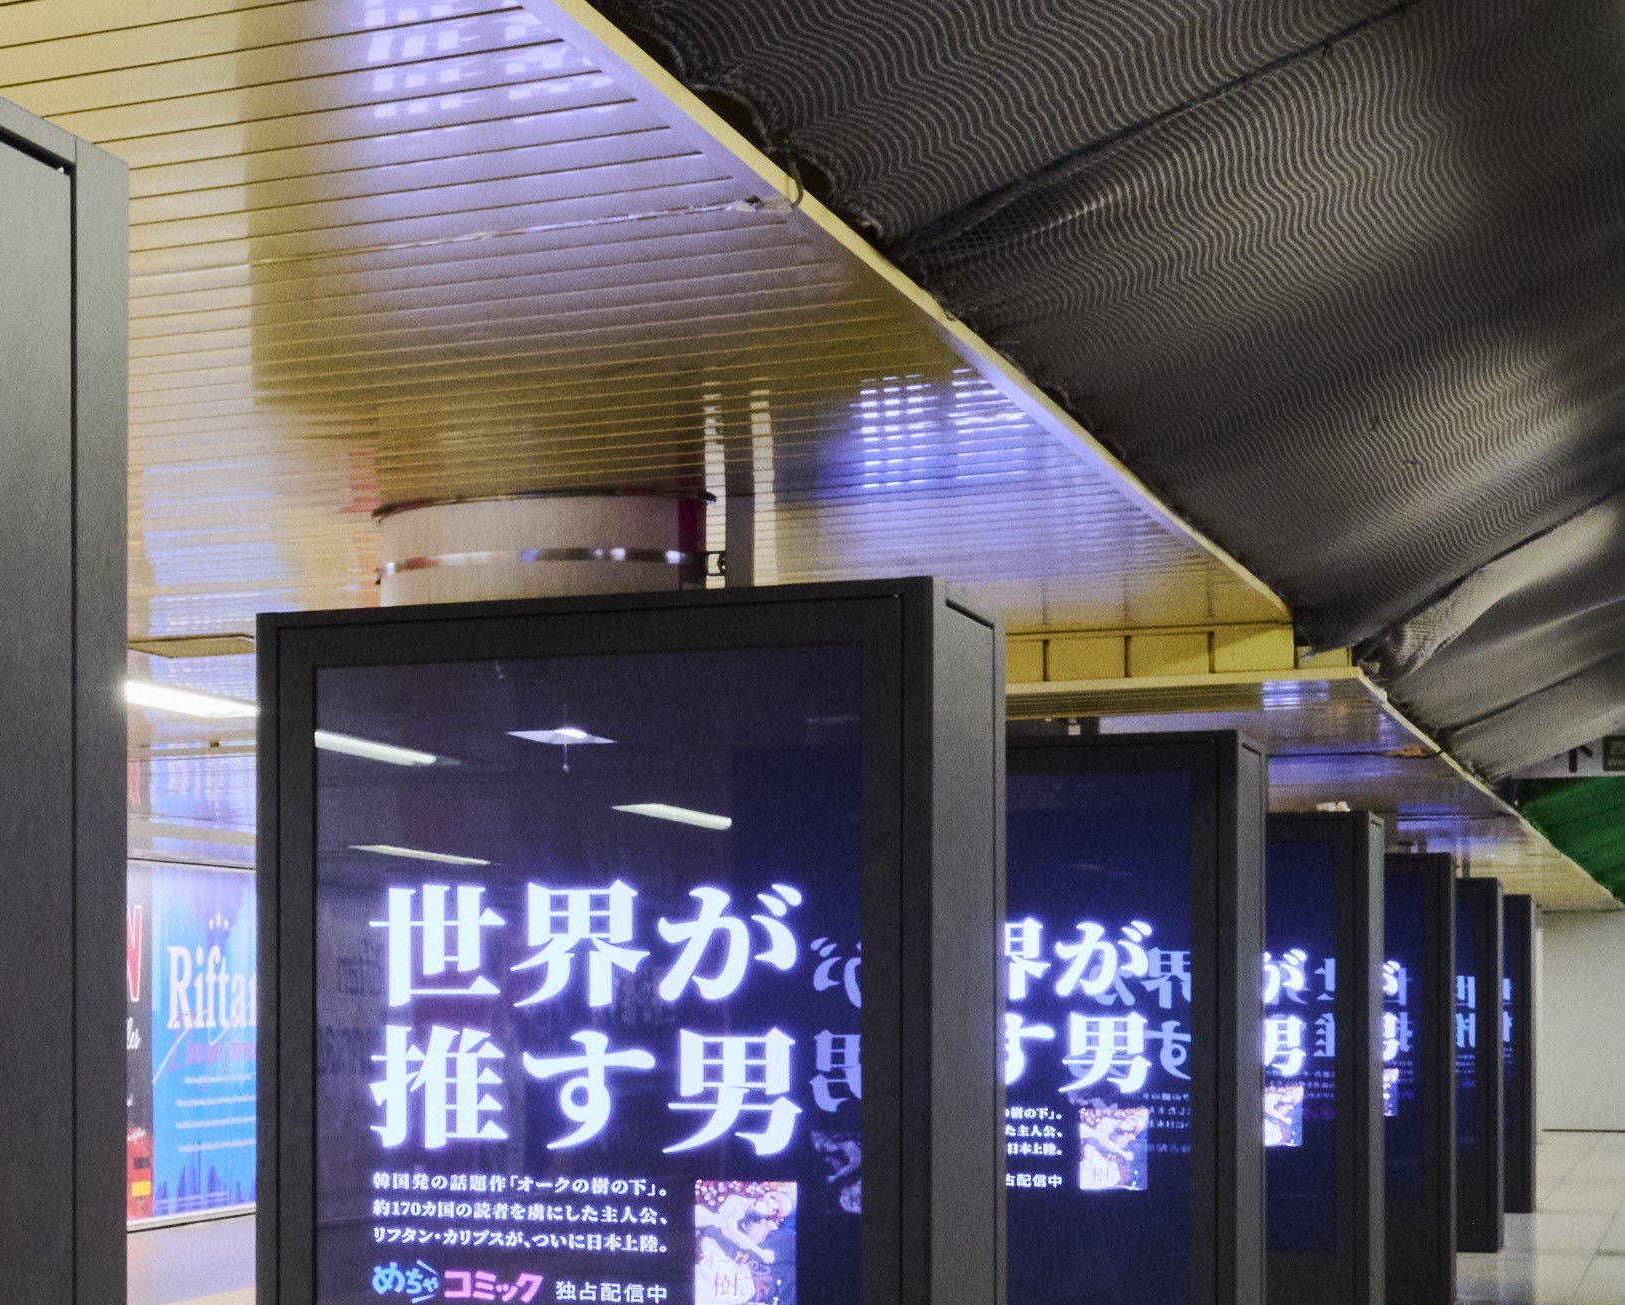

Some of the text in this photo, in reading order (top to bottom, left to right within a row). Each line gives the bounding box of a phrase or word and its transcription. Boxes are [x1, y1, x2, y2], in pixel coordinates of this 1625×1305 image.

[369, 880, 802, 1007] 世界が
[369, 1024, 802, 1155] 推す男
[555, 1279, 668, 1304] 独占配信中
